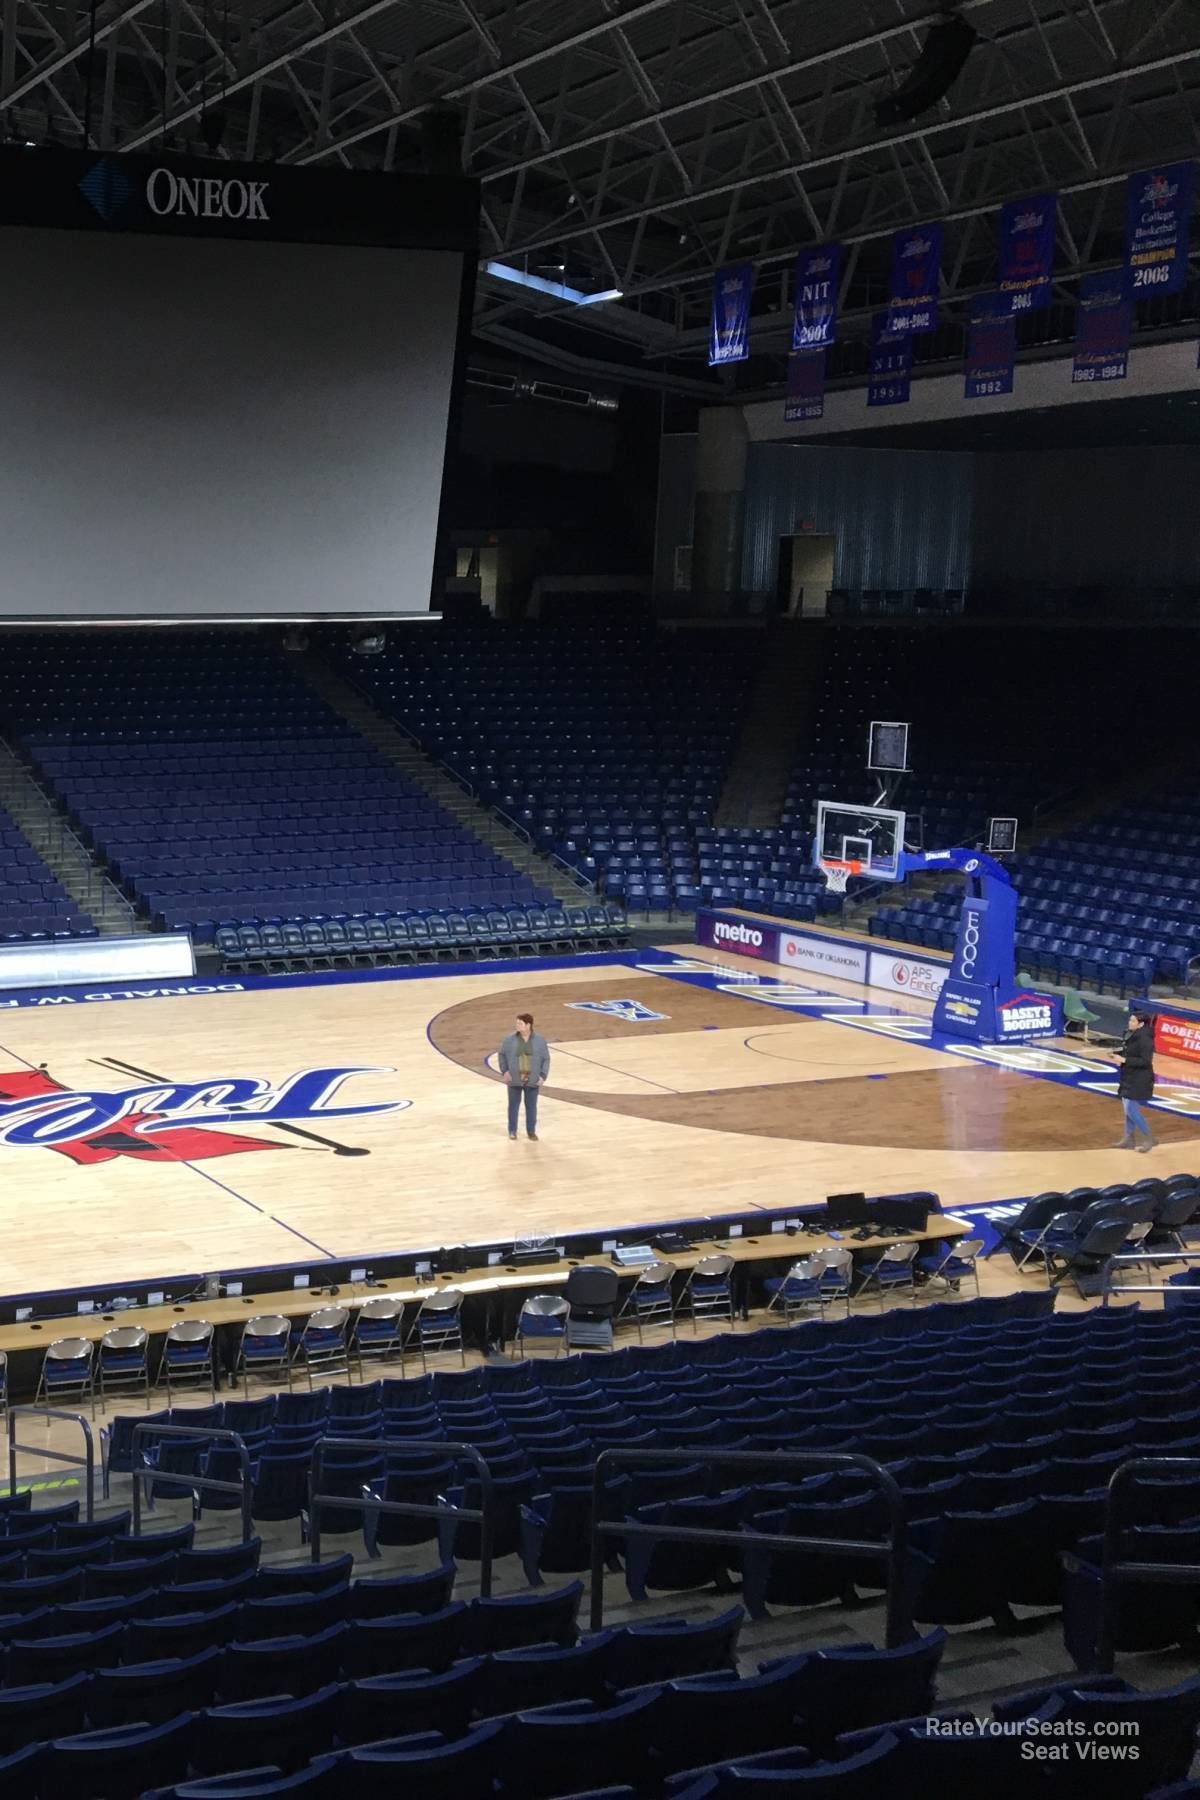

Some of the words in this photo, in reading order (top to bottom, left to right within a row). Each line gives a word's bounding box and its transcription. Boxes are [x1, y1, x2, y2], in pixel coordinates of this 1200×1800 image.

[146, 168, 270, 220] ONEOK
[1133, 265, 1170, 287] 2008
[802, 281, 832, 302] NIT
[800, 323, 828, 344] 2001
[975, 380, 1001, 394] 1982
[713, 921, 763, 947] metro
[797, 947, 815, 959] BANK
[816, 951, 825, 960] OF
[825, 954, 861, 968] OKLAHOMA
[912, 966, 933, 980] APS
[29, 995, 77, 1006] W.
[84, 983, 245, 1001] DONALD
[1003, 1017, 1052, 1032] ROOFING
